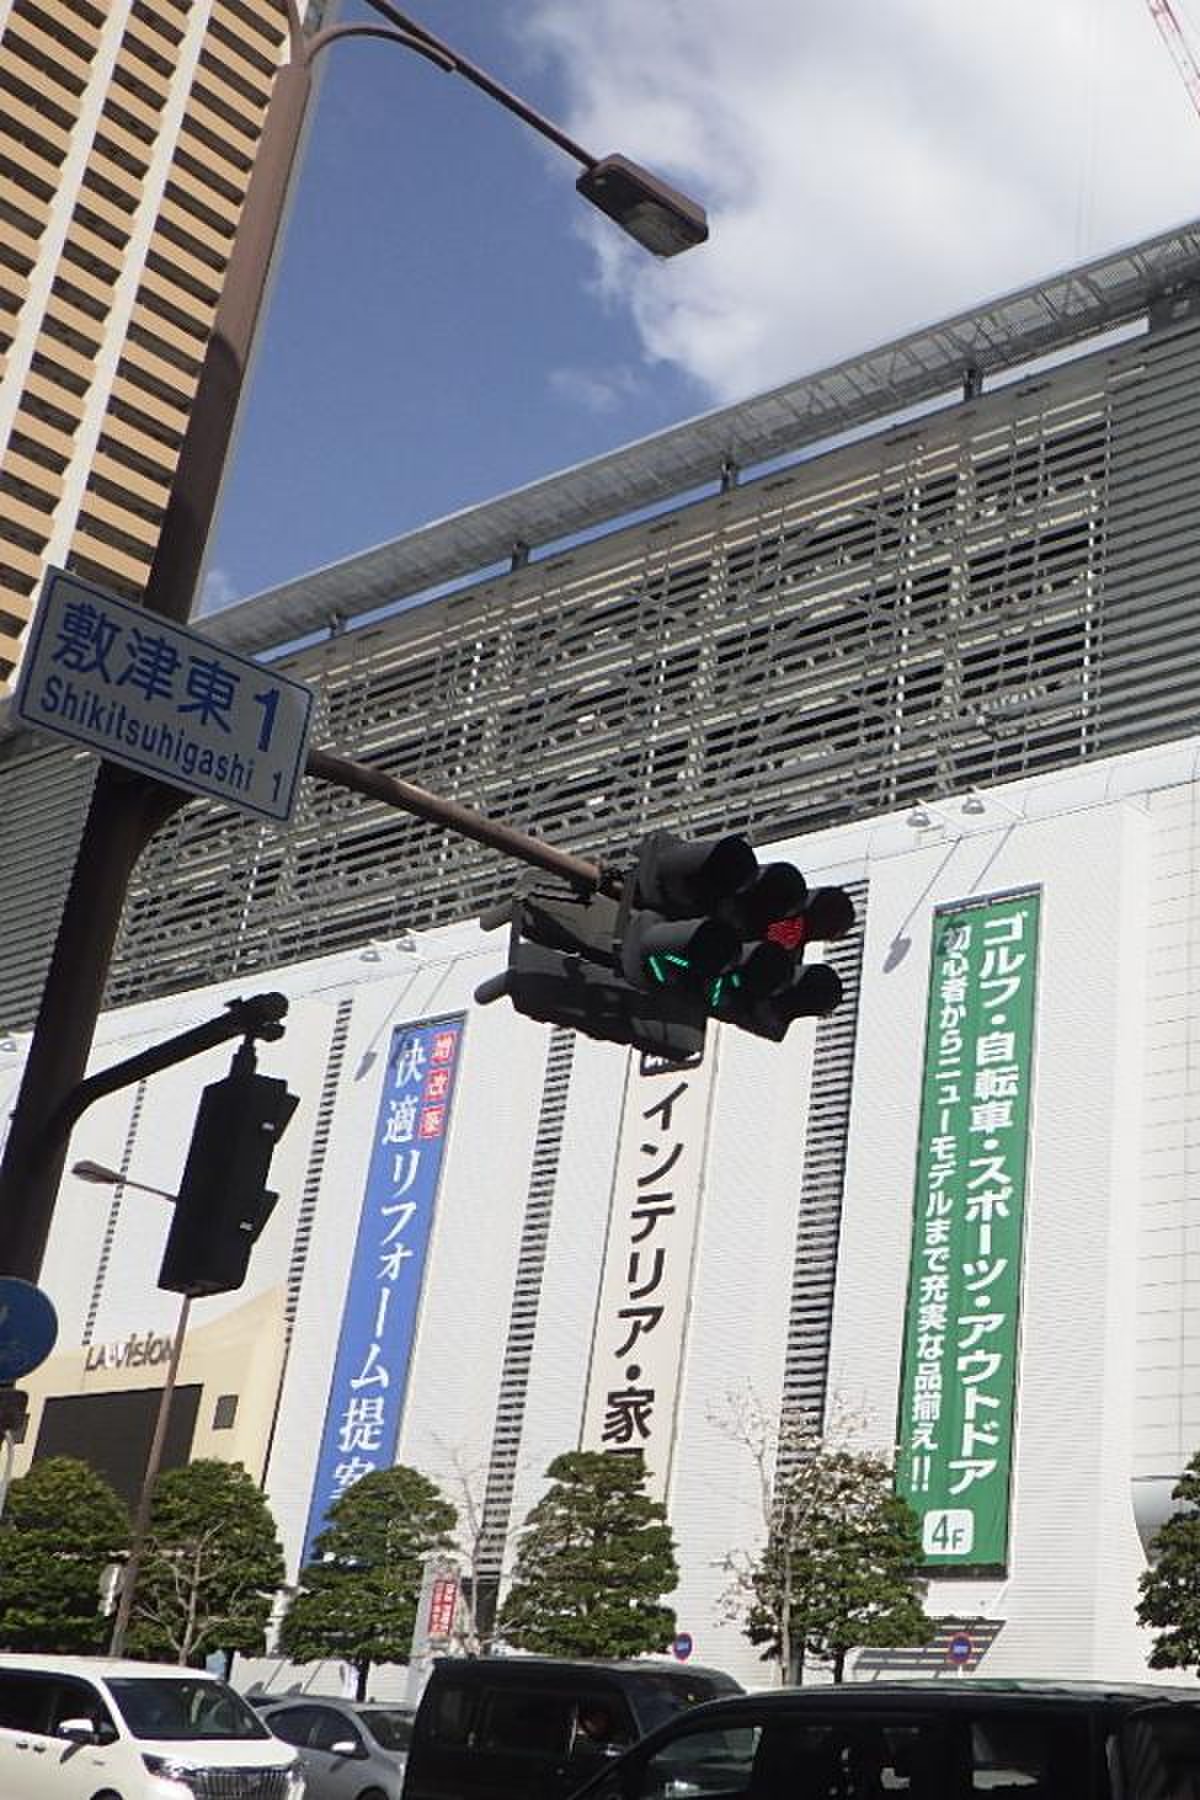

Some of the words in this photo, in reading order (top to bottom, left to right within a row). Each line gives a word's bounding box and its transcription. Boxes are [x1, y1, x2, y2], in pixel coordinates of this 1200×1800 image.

[41, 675, 256, 792] Shikitsuhigashi
[272, 771, 283, 802] 1
[602, 1082, 689, 1456] インテリア・家
[931, 1515, 965, 1550] 4F
